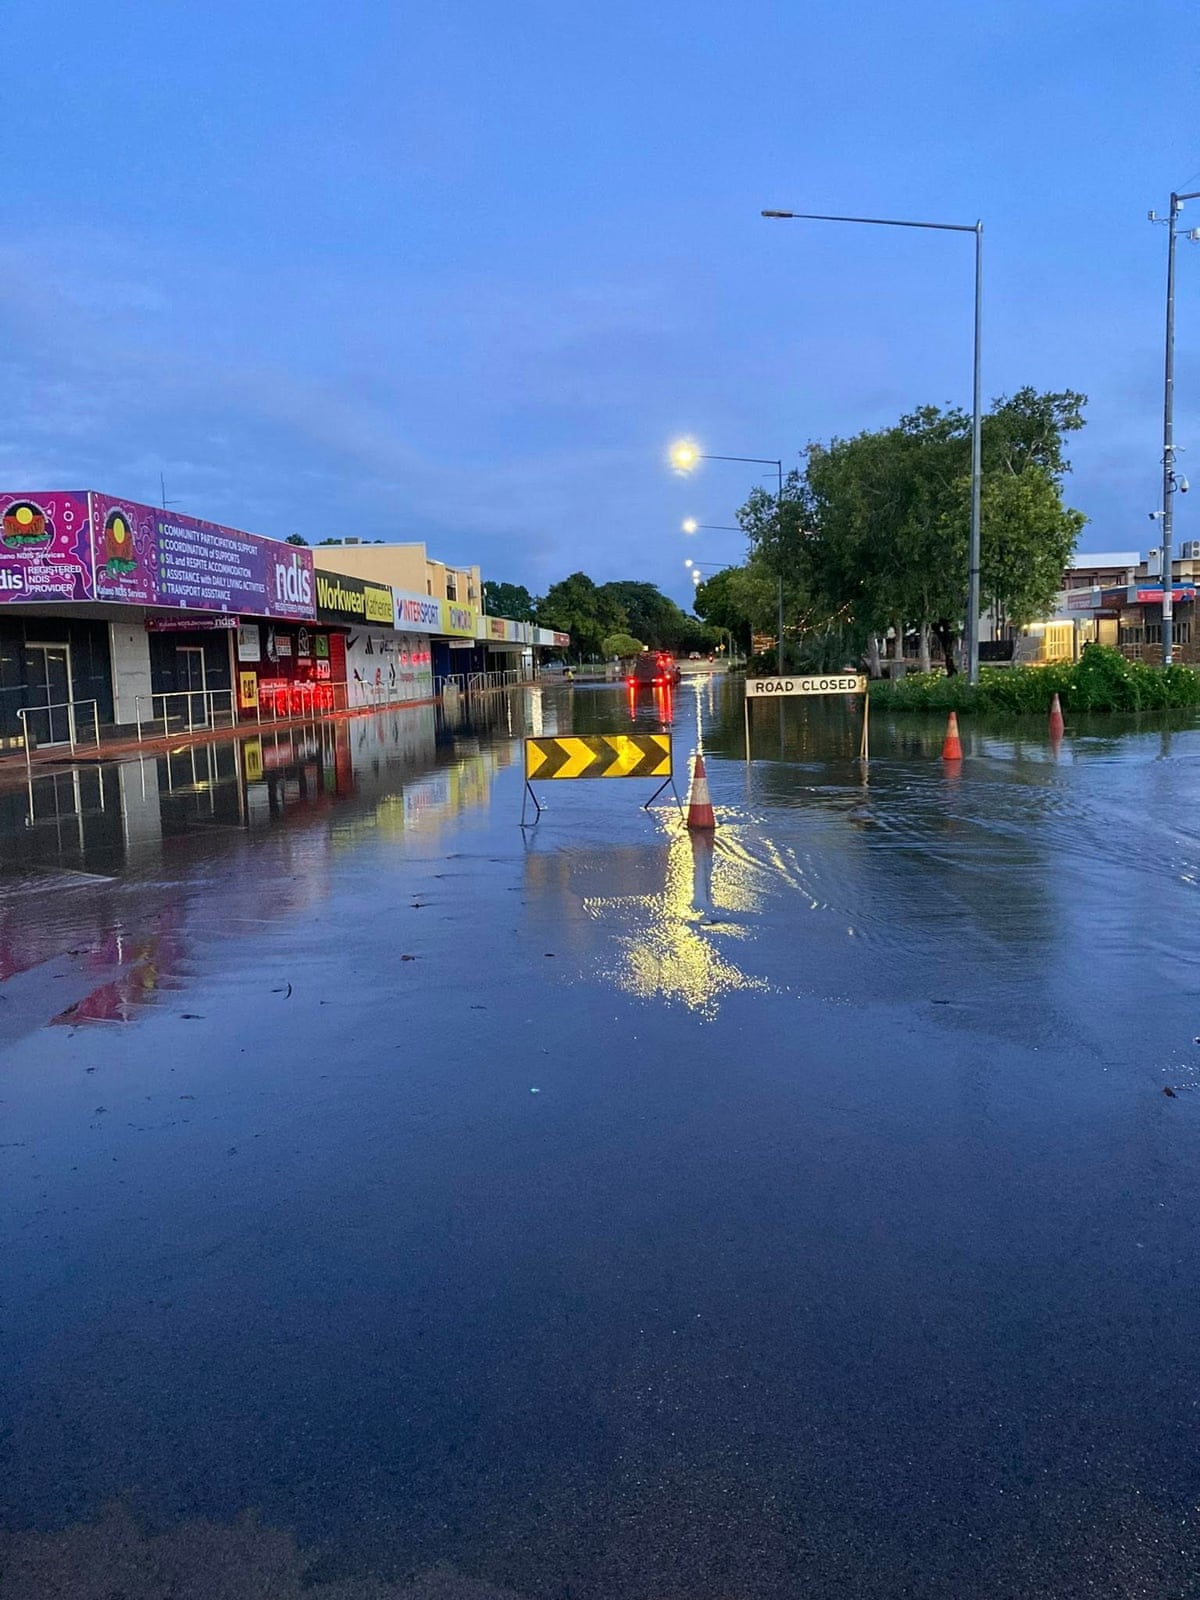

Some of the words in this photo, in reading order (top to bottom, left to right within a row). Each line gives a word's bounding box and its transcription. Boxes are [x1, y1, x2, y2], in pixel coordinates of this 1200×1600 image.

[164, 524, 200, 542] COMMUNITY
[201, 532, 237, 550] PARTICIPATION
[237, 541, 258, 556] SUPPORT
[165, 539, 208, 557] COORDINATION
[215, 549, 240, 564] SUPPORTS
[28, 565, 81, 575] REGISTERED
[166, 553, 174, 565] SIL
[175, 556, 186, 567] and
[186, 557, 208, 571] RESPITE
[208, 560, 251, 578] ACCOMMODATION
[28, 575, 50, 584] NDIS
[30, 584, 73, 593] PROVIDER
[166, 569, 200, 584] ASSISTANCE
[201, 574, 212, 585] with
[213, 575, 227, 588] DAILY
[227, 578, 242, 590] LIVING
[242, 580, 265, 594] ACTIVITIES
[275, 553, 311, 604] ndis
[167, 584, 200, 598] TRANSPORT
[201, 587, 231, 602] ASSISTANCE
[316, 577, 365, 614] Workwear
[215, 616, 235, 627] ndis
[404, 598, 438, 625] INTERSPORT
[243, 680, 255, 699] CAT
[756, 681, 794, 693] ROAD
[801, 678, 857, 691] CLOSED
